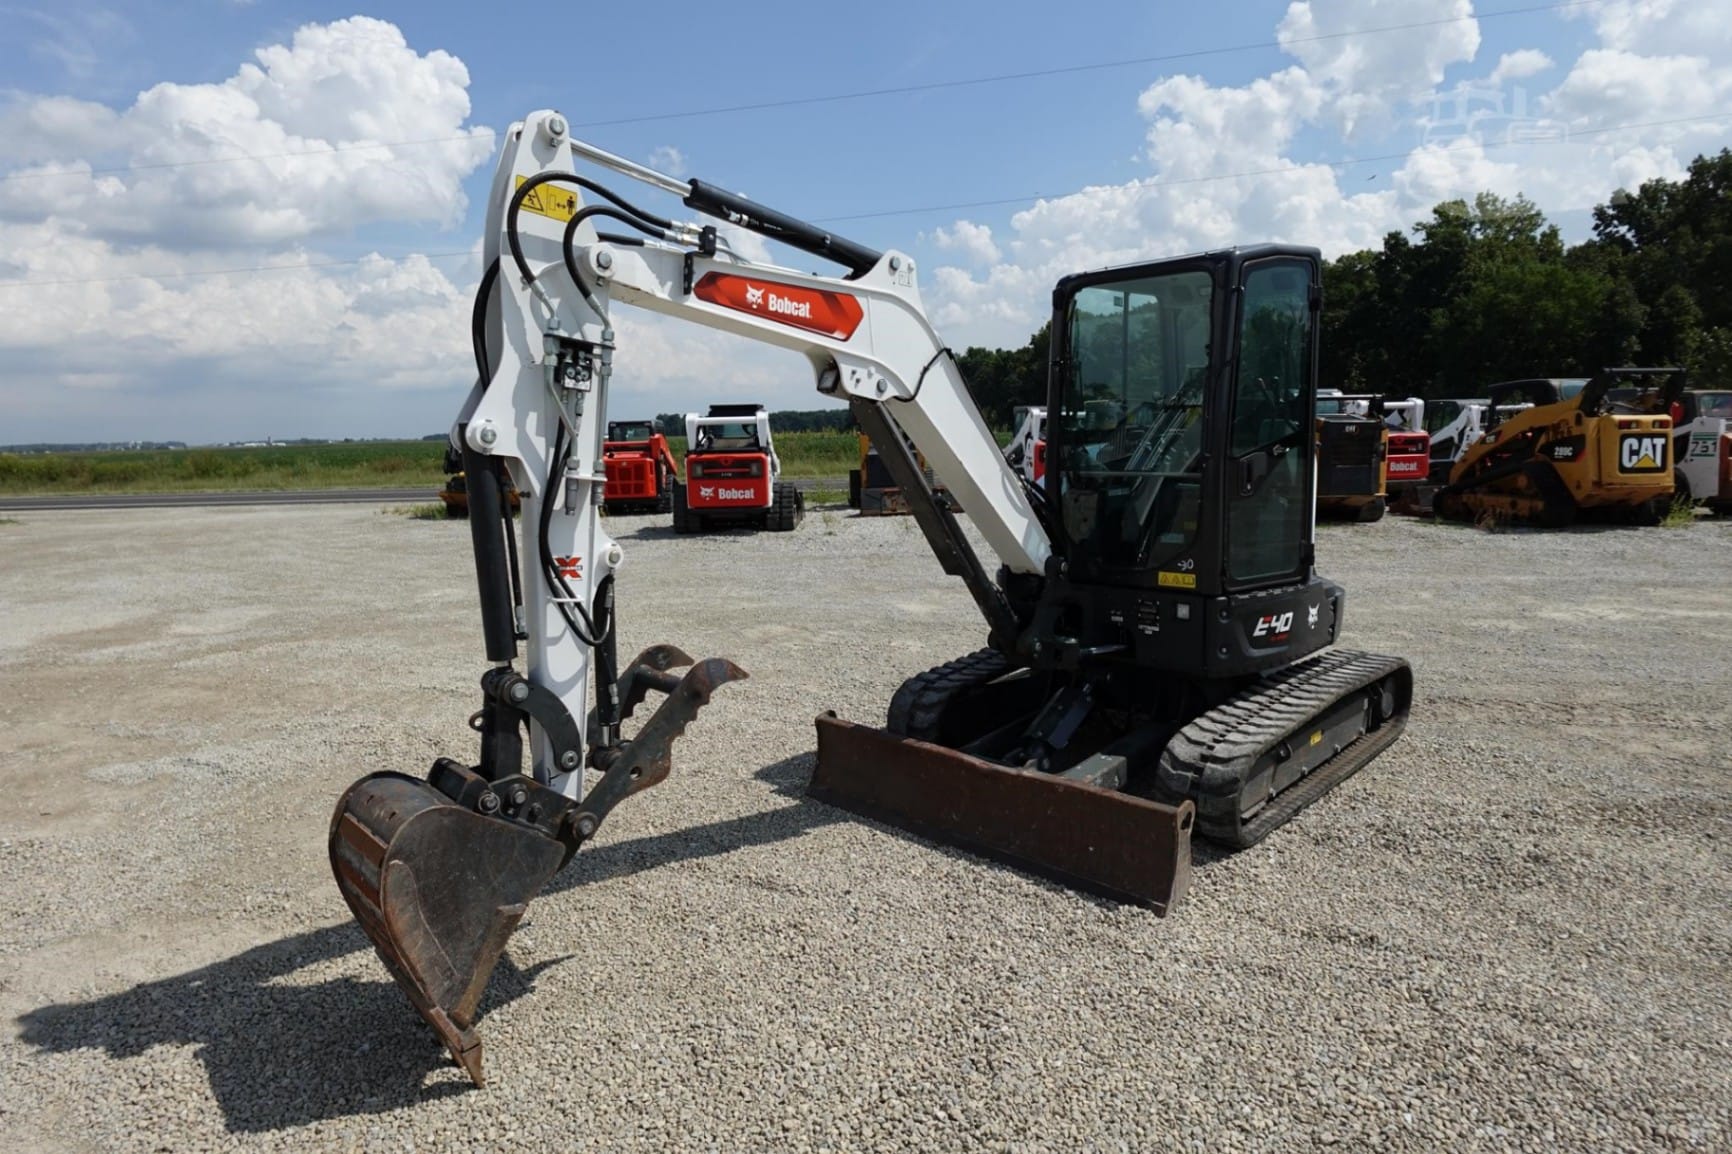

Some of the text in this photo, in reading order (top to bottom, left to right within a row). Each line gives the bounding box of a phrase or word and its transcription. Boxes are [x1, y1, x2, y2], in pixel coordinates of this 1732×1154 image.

[768, 294, 811, 318] Bobcat
[1622, 437, 1666, 468] CAT
[1691, 441, 1717, 453] 751
[1390, 462, 1417, 471] Bobcat
[718, 488, 755, 500] Bobcat
[1252, 611, 1294, 637] E40
